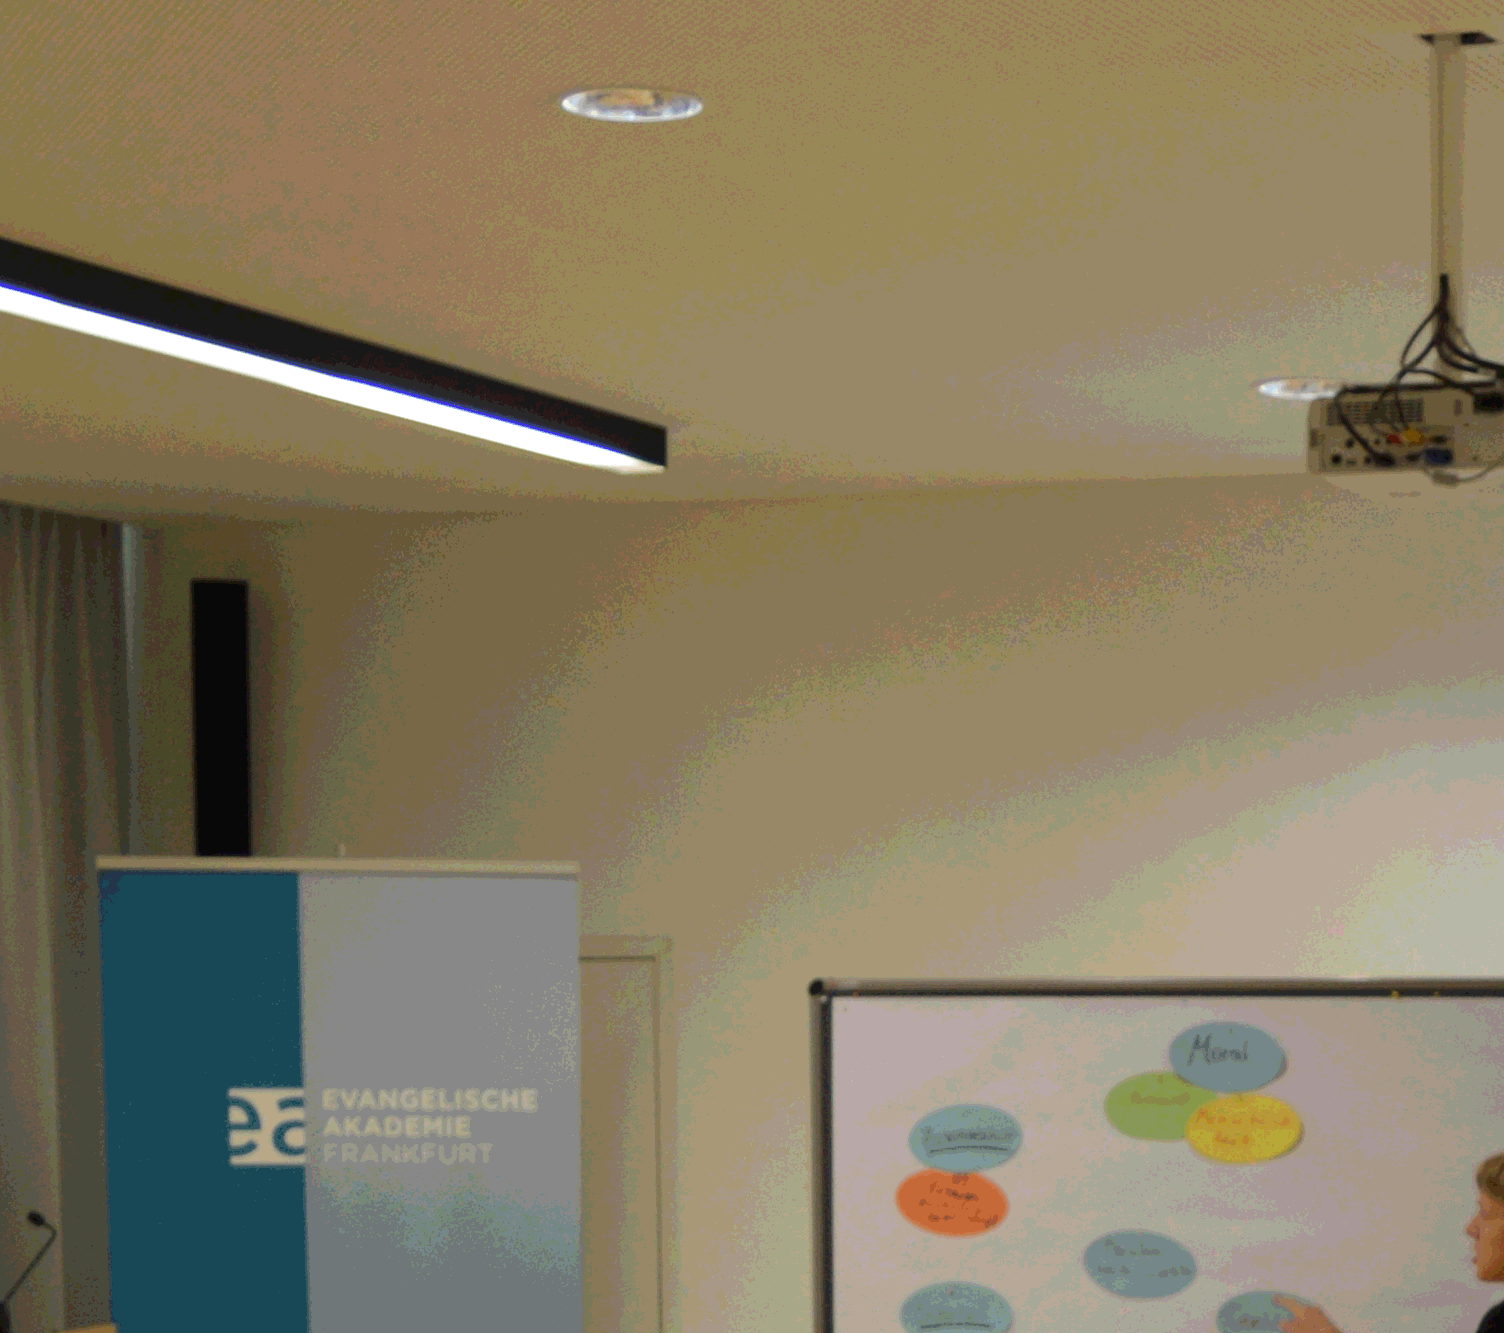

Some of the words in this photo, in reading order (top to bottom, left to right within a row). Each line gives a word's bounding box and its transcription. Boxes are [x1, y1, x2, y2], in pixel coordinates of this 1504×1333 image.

[321, 1087, 539, 1112] EVANGELISCHE
[323, 1115, 472, 1139] AKADEMIE
[323, 1142, 493, 1165] FRANKFURT
